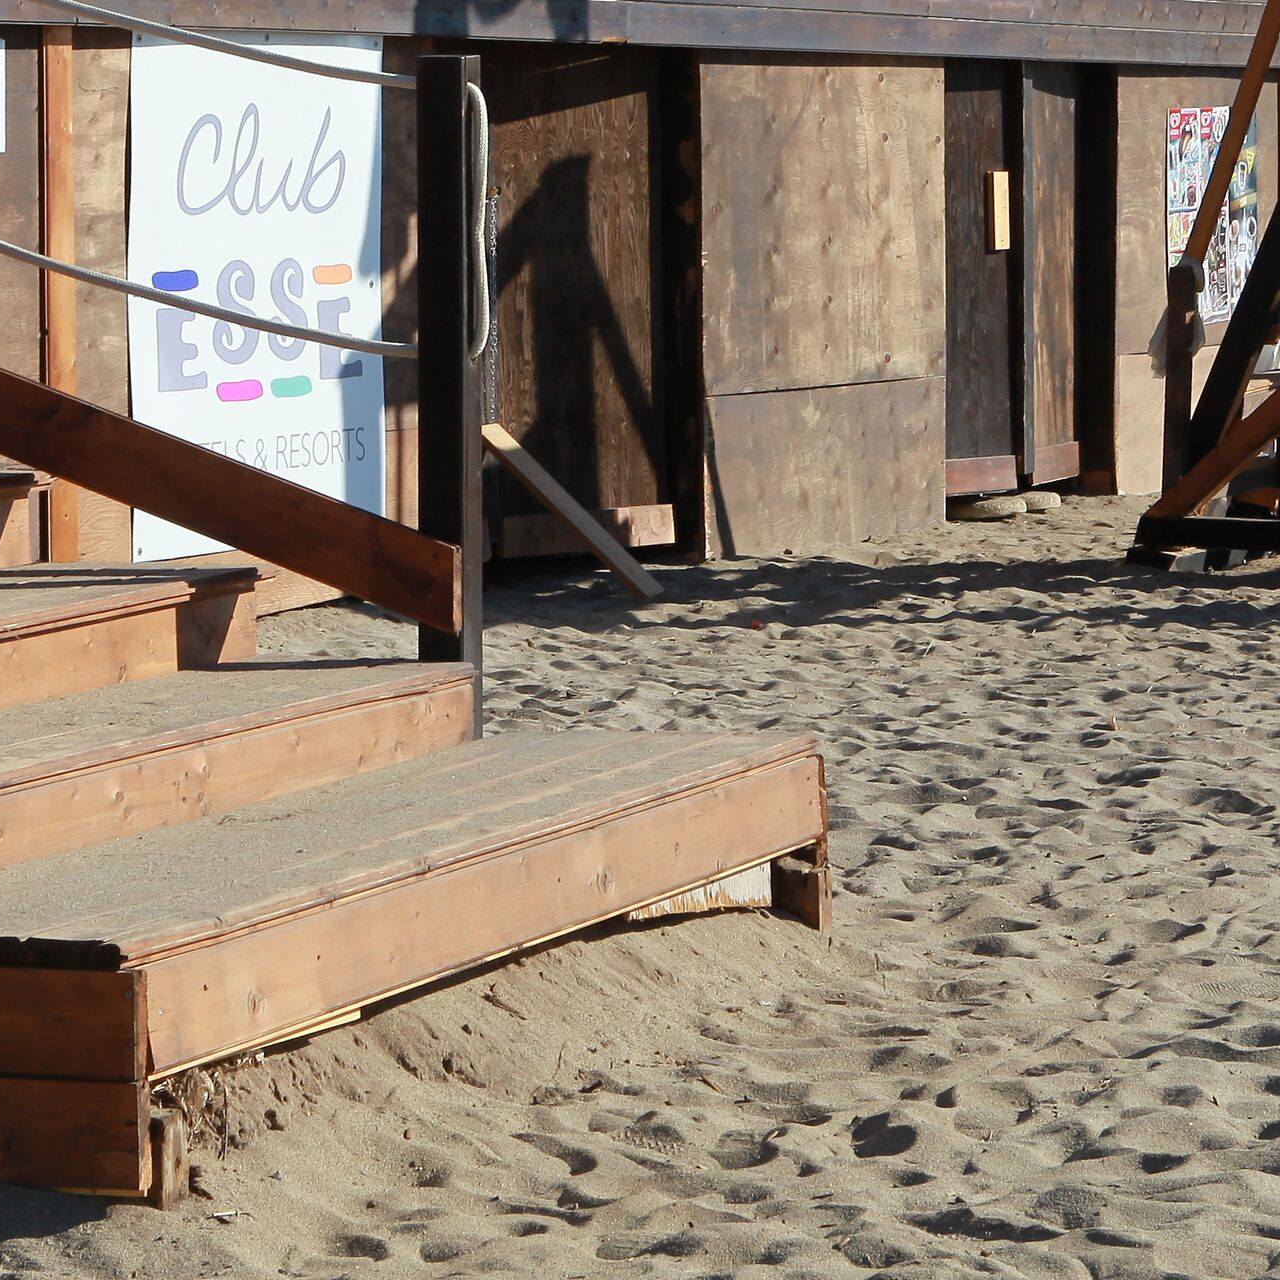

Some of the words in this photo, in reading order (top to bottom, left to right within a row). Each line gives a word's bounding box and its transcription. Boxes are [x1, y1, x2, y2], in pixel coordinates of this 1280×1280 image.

[177, 103, 346, 215] Club
[157, 258, 363, 393] ESSE
[276, 427, 366, 471] RESORTS
